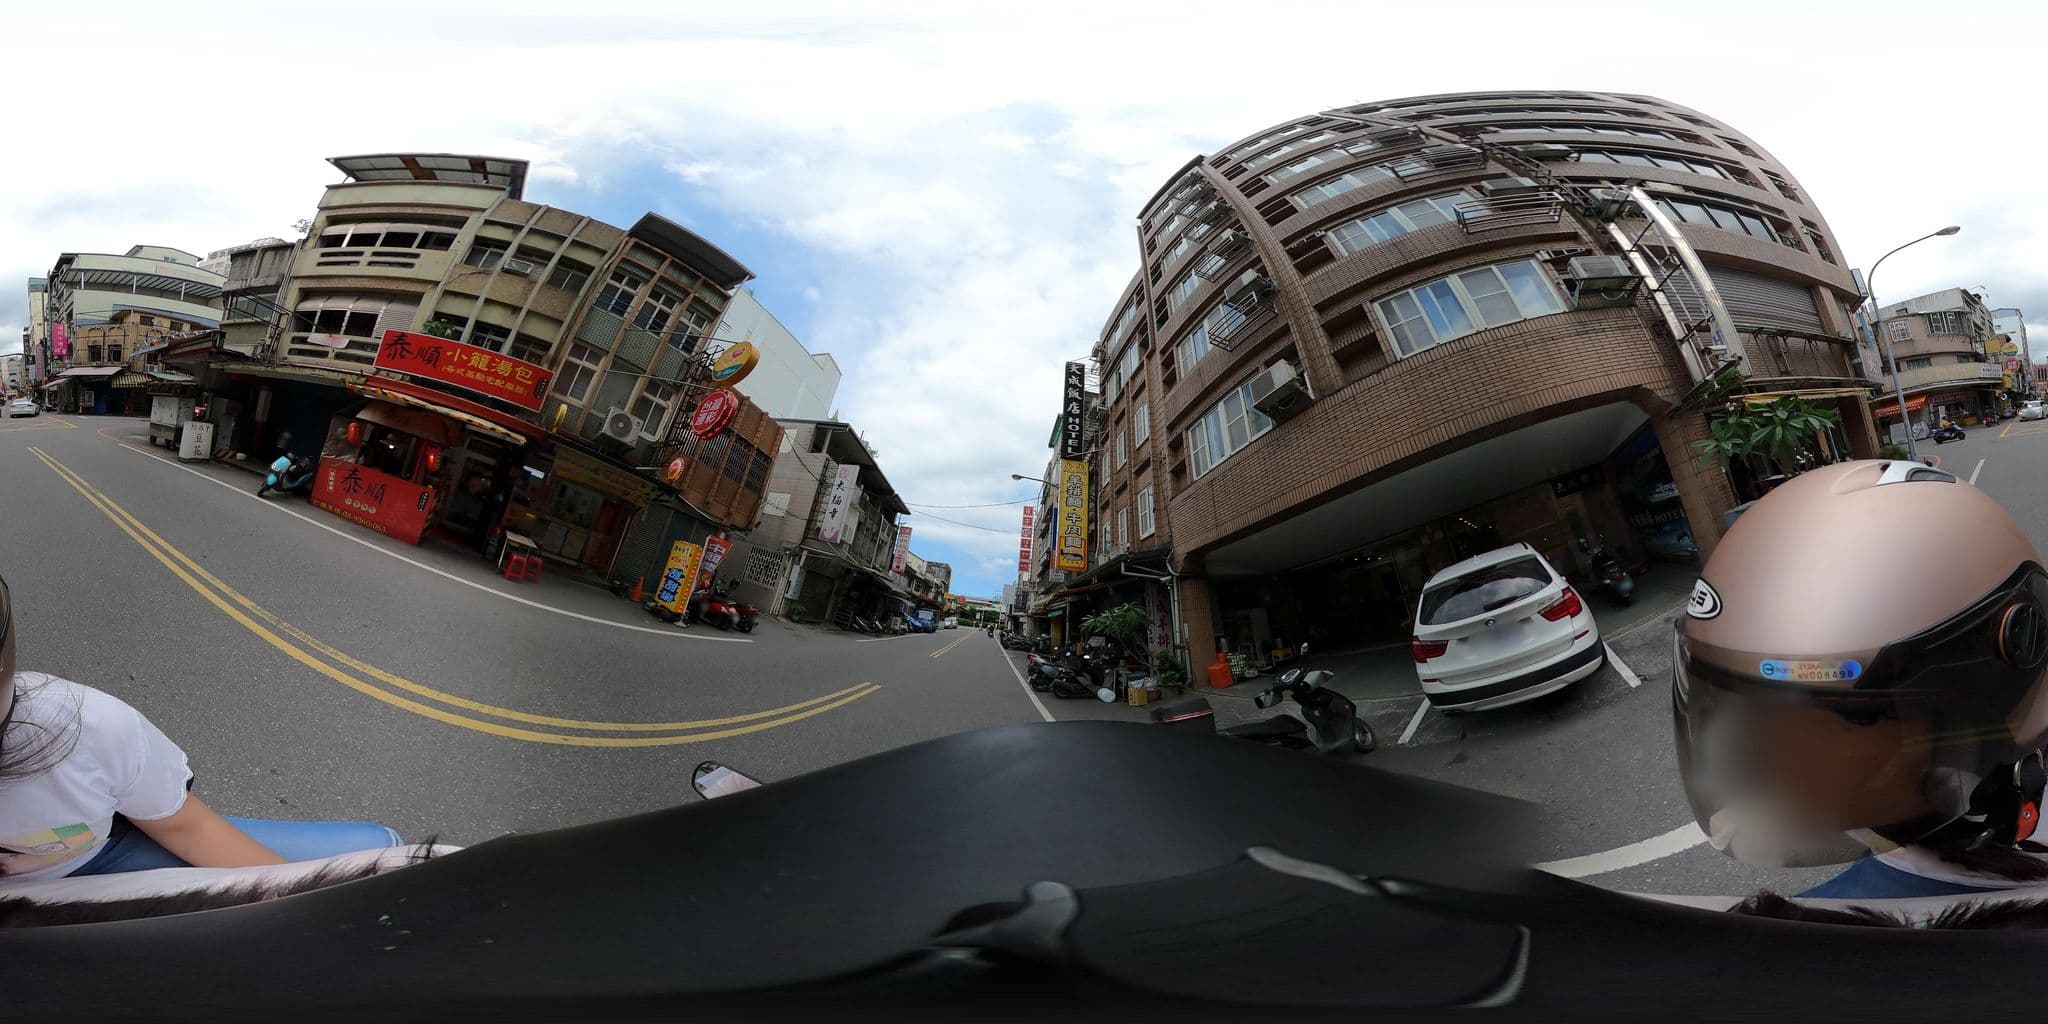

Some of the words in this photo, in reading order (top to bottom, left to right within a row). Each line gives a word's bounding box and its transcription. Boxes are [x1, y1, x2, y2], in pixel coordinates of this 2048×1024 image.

[382, 332, 443, 369] 泰順
[446, 347, 535, 385] 小籠湯包
[1067, 362, 1083, 415] 大成飯店
[1067, 417, 1080, 454] HOTEL
[342, 467, 387, 505] 泰順
